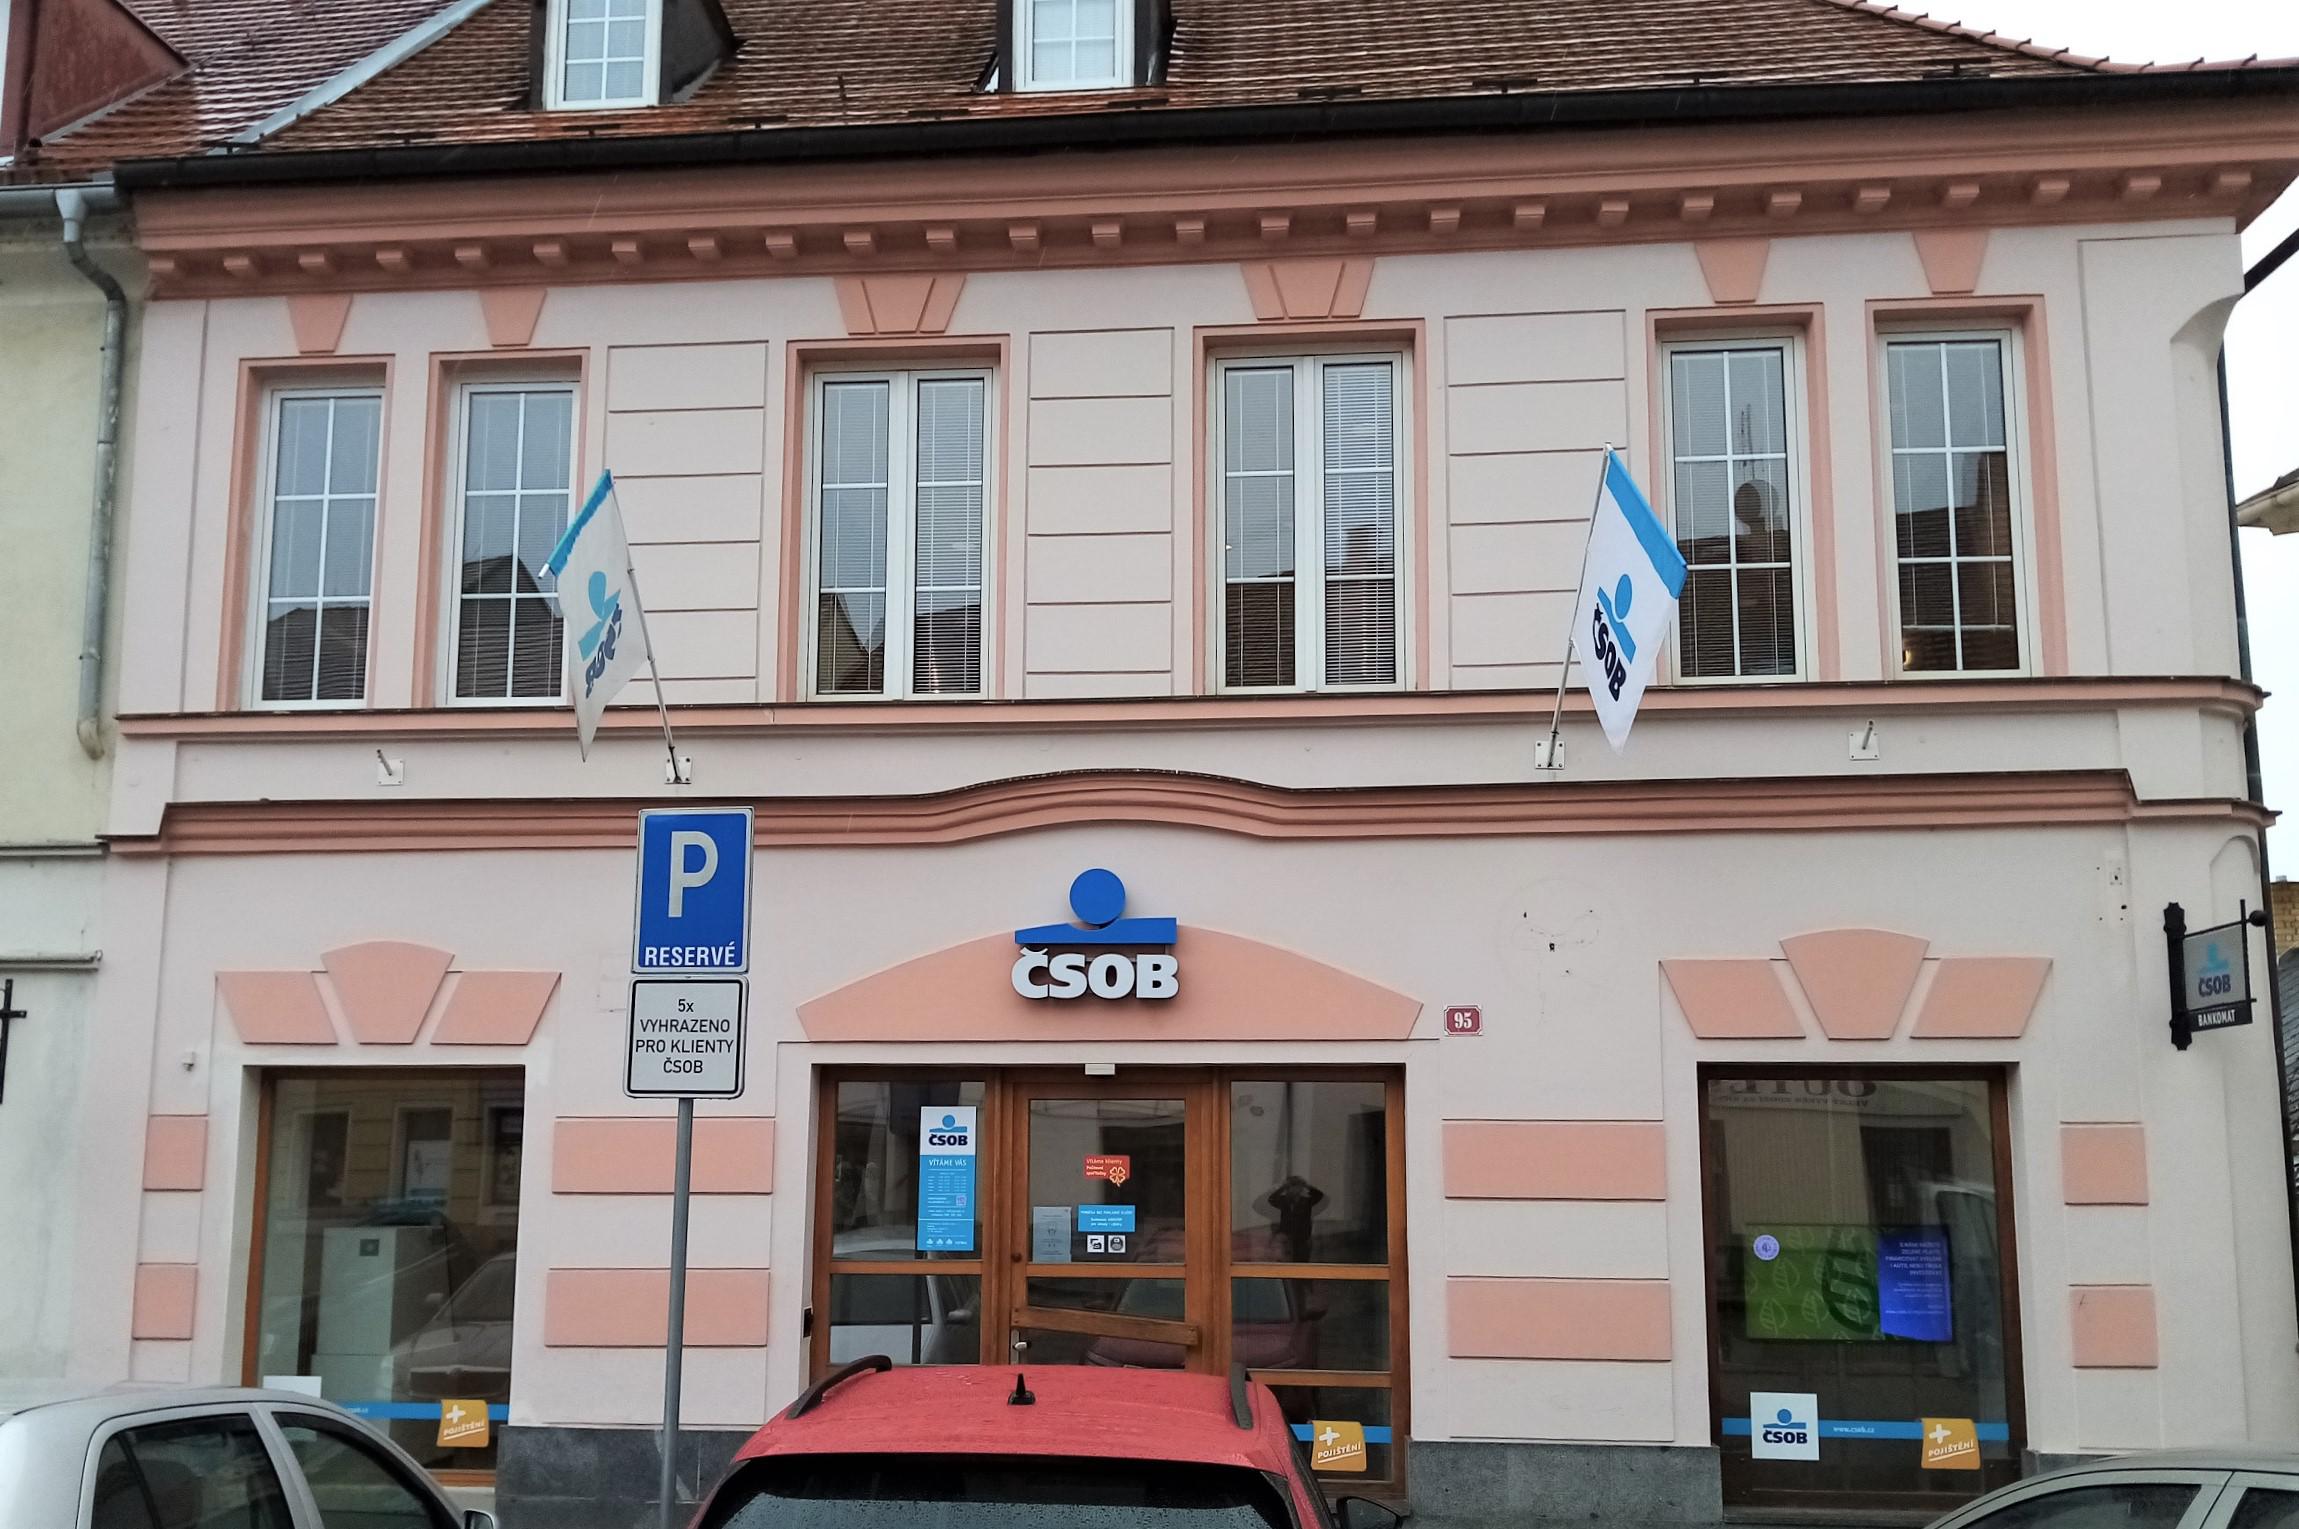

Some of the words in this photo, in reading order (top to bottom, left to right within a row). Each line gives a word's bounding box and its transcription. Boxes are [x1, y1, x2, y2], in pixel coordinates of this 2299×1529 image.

[667, 830, 719, 918] P
[644, 941, 736, 967] RESERVÉ
[1011, 946, 1179, 1000] ČSOB
[677, 998, 694, 1013] 5x
[639, 1018, 731, 1033] VYHRAZENO
[1453, 1011, 1473, 1029] 95
[2198, 1009, 2236, 1027] BANKOMAT
[635, 1039, 666, 1054] PRO
[671, 1038, 734, 1054] KLIENTY
[662, 1057, 704, 1074] ČSOB
[928, 1133, 968, 1146] ČSOB
[1762, 1429, 1808, 1444] ČSOB
[1317, 1441, 1362, 1459] POJIŠTĚNÍ
[1928, 1439, 1974, 1457] POJIŠTĚNÍ
